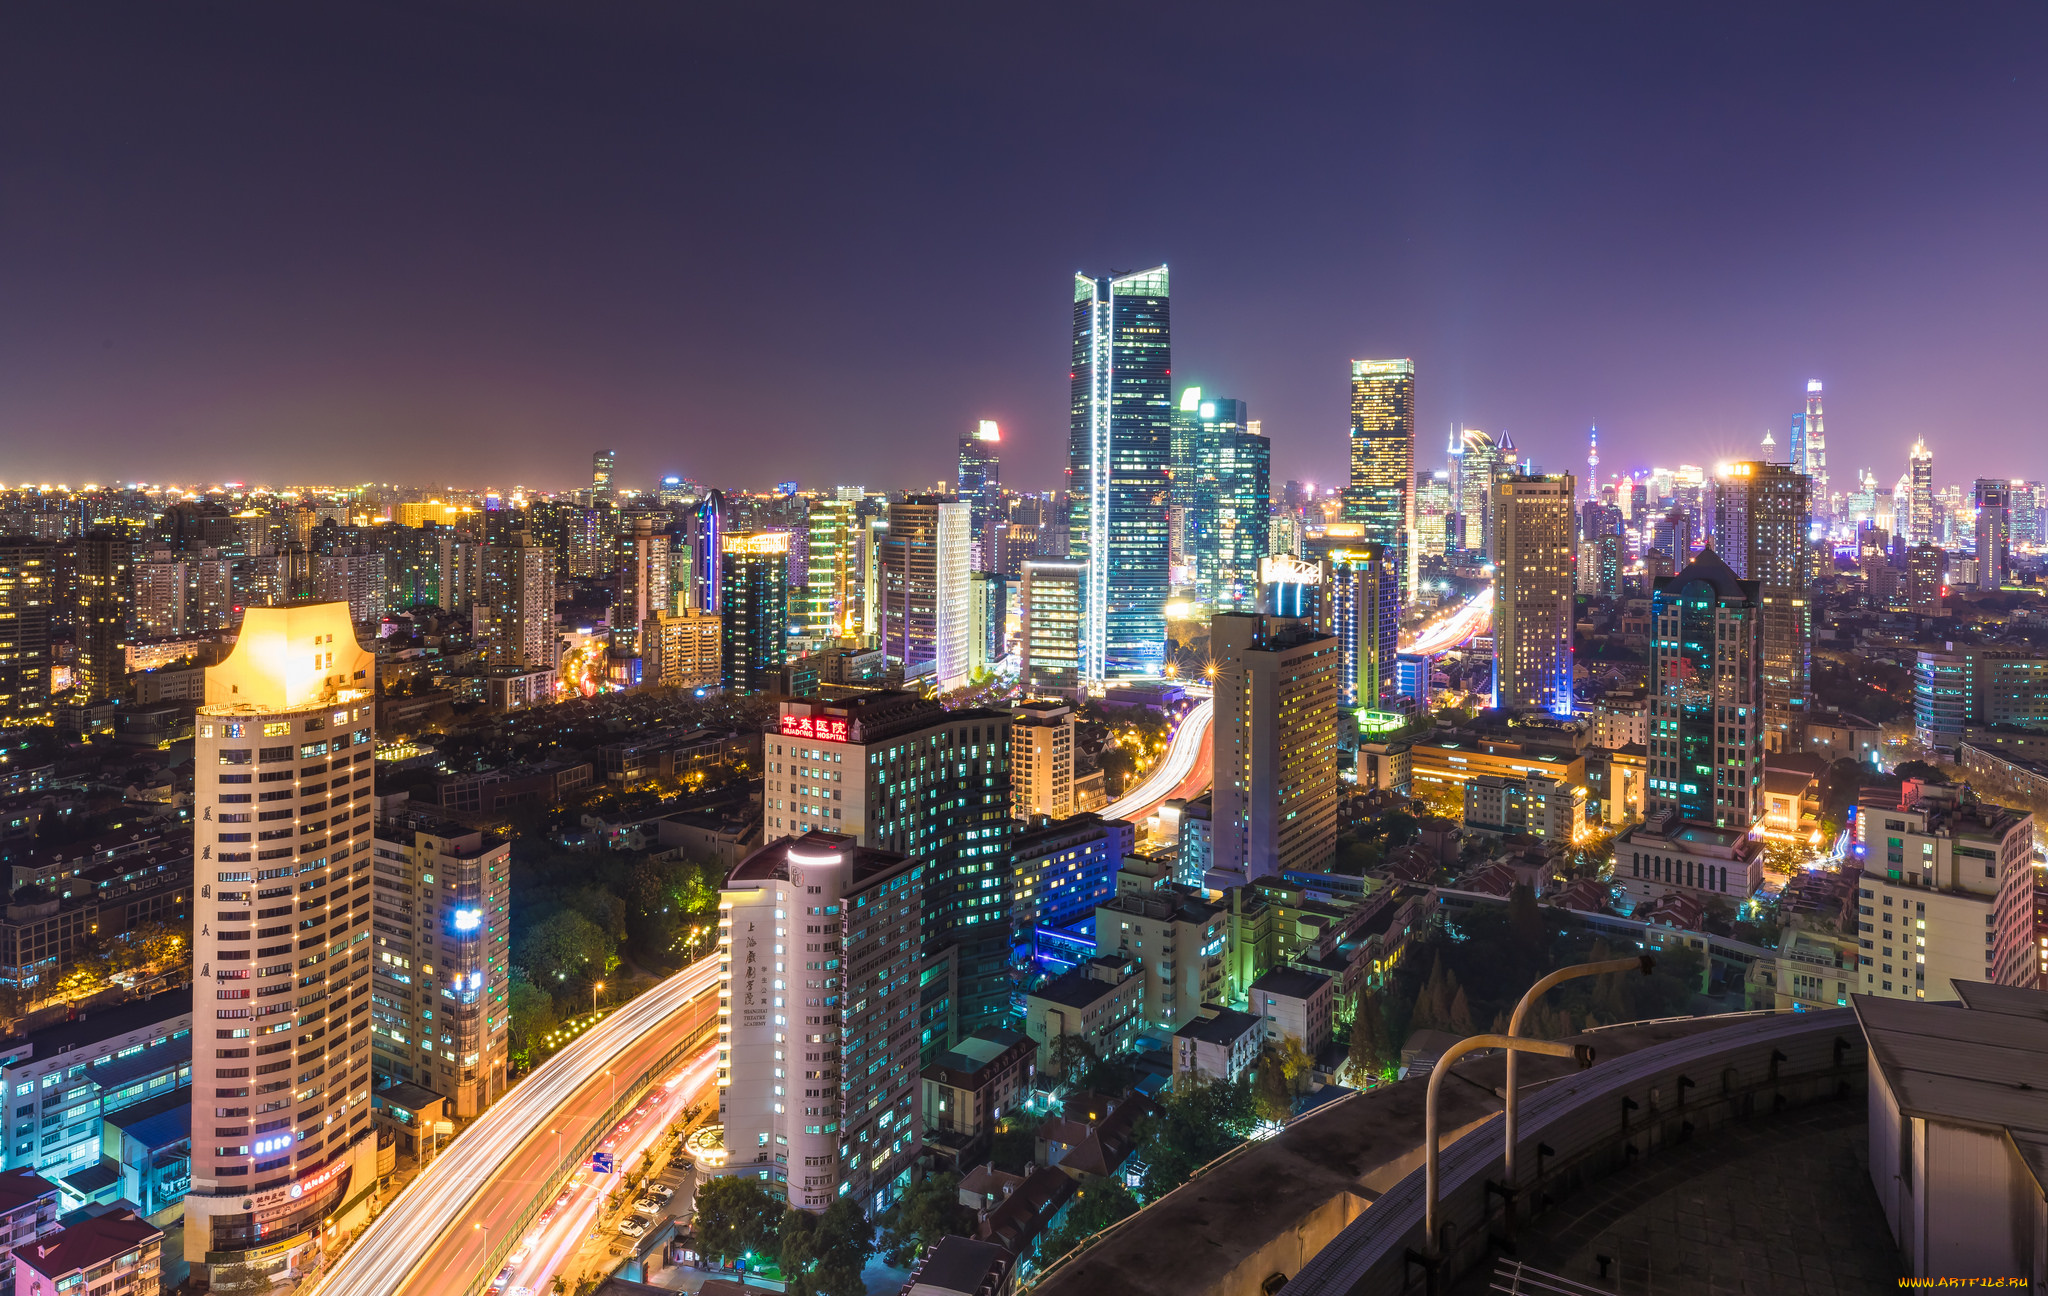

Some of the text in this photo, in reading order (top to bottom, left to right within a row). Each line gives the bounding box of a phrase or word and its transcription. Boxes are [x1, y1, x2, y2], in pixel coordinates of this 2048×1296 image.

[783, 715, 847, 735] 华东医院
[783, 727, 847, 742] HUADONG HOSPITAL
